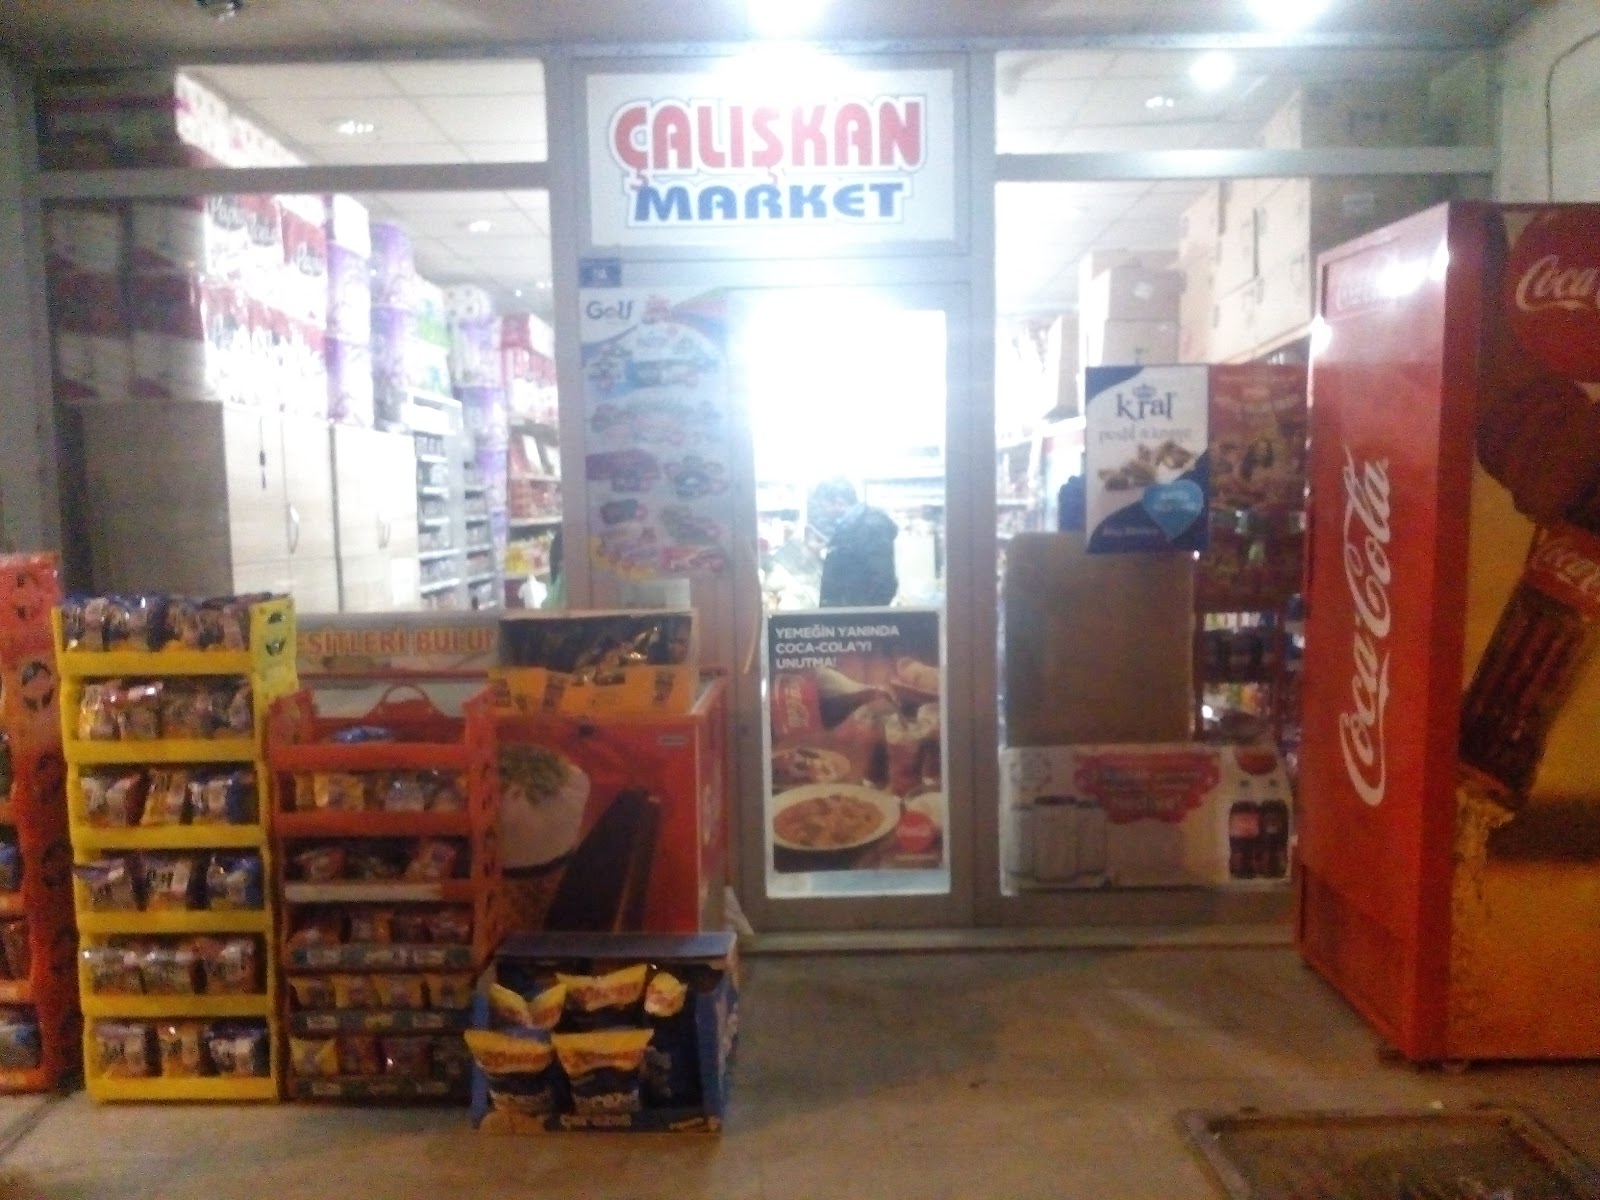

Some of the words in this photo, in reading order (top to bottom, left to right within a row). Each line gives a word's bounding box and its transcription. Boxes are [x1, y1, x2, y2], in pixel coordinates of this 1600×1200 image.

[613, 101, 923, 190] ÇALIŞKAN
[634, 182, 904, 222] MARKET
[775, 624, 835, 639] YEMEĞİN
[838, 625, 900, 637] YANINDA
[1338, 445, 1392, 806] Coca-Cola
[775, 657, 837, 670] UNUTMA!
